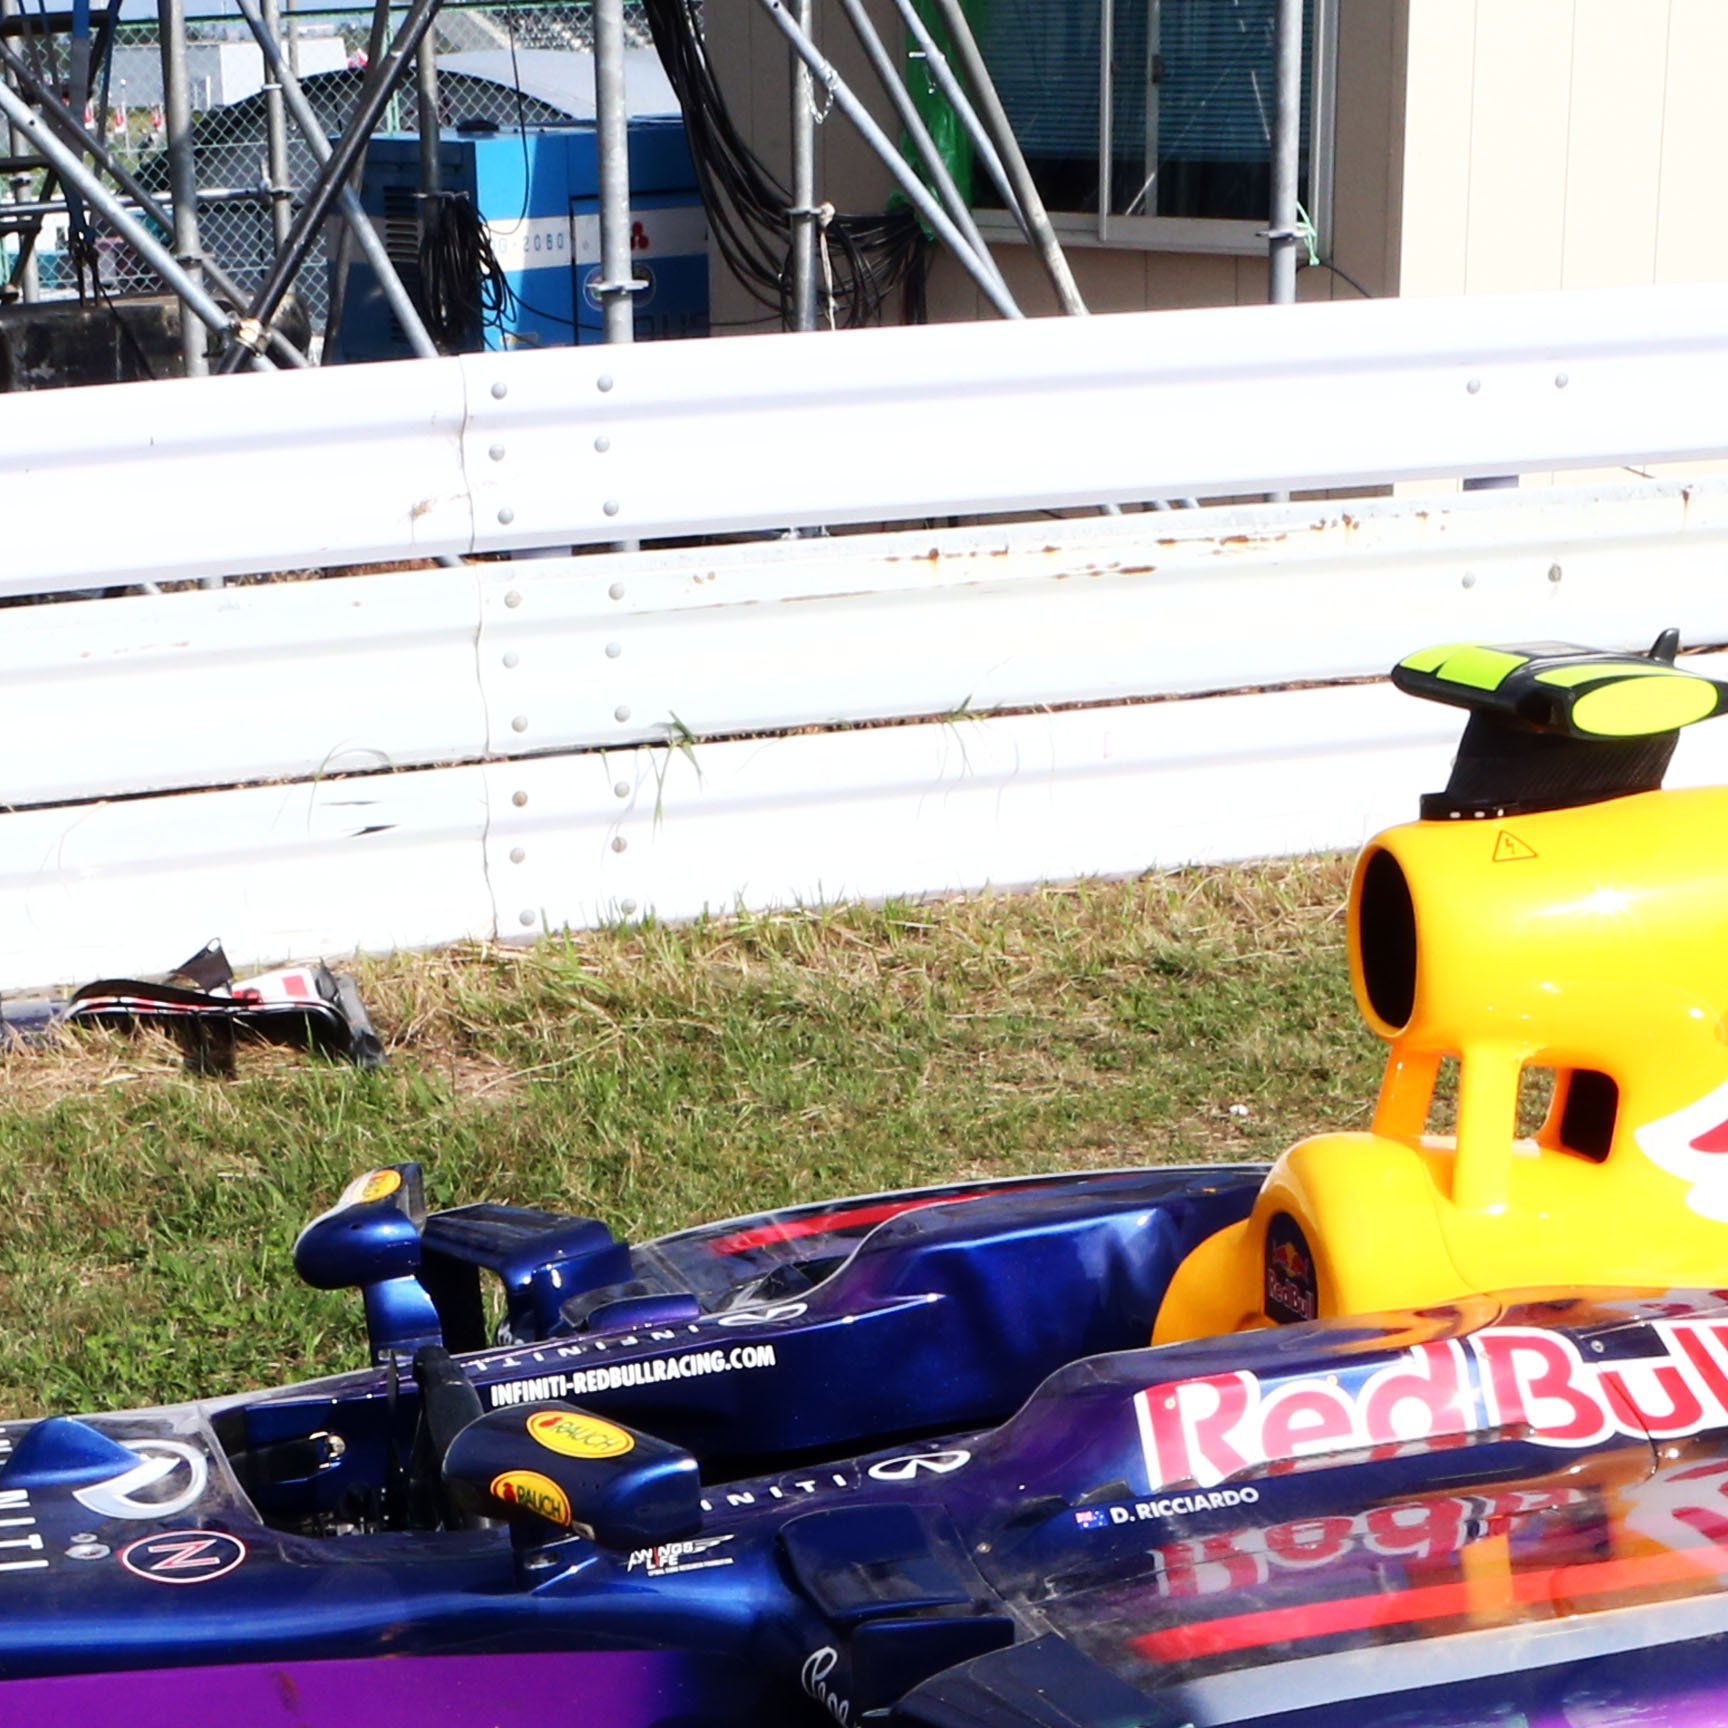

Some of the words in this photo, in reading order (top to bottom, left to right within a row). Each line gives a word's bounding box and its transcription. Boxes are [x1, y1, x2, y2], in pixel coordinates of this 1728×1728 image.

[491, 1345, 776, 1406] INFINITI-REDBULLRACING.COM
[1134, 1338, 1471, 1490] Red
[550, 1421, 620, 1451] RAUCH
[516, 1485, 562, 1520] RAUCH
[1110, 1507, 1136, 1525] D.
[1135, 1487, 1259, 1520] RICCIARDO
